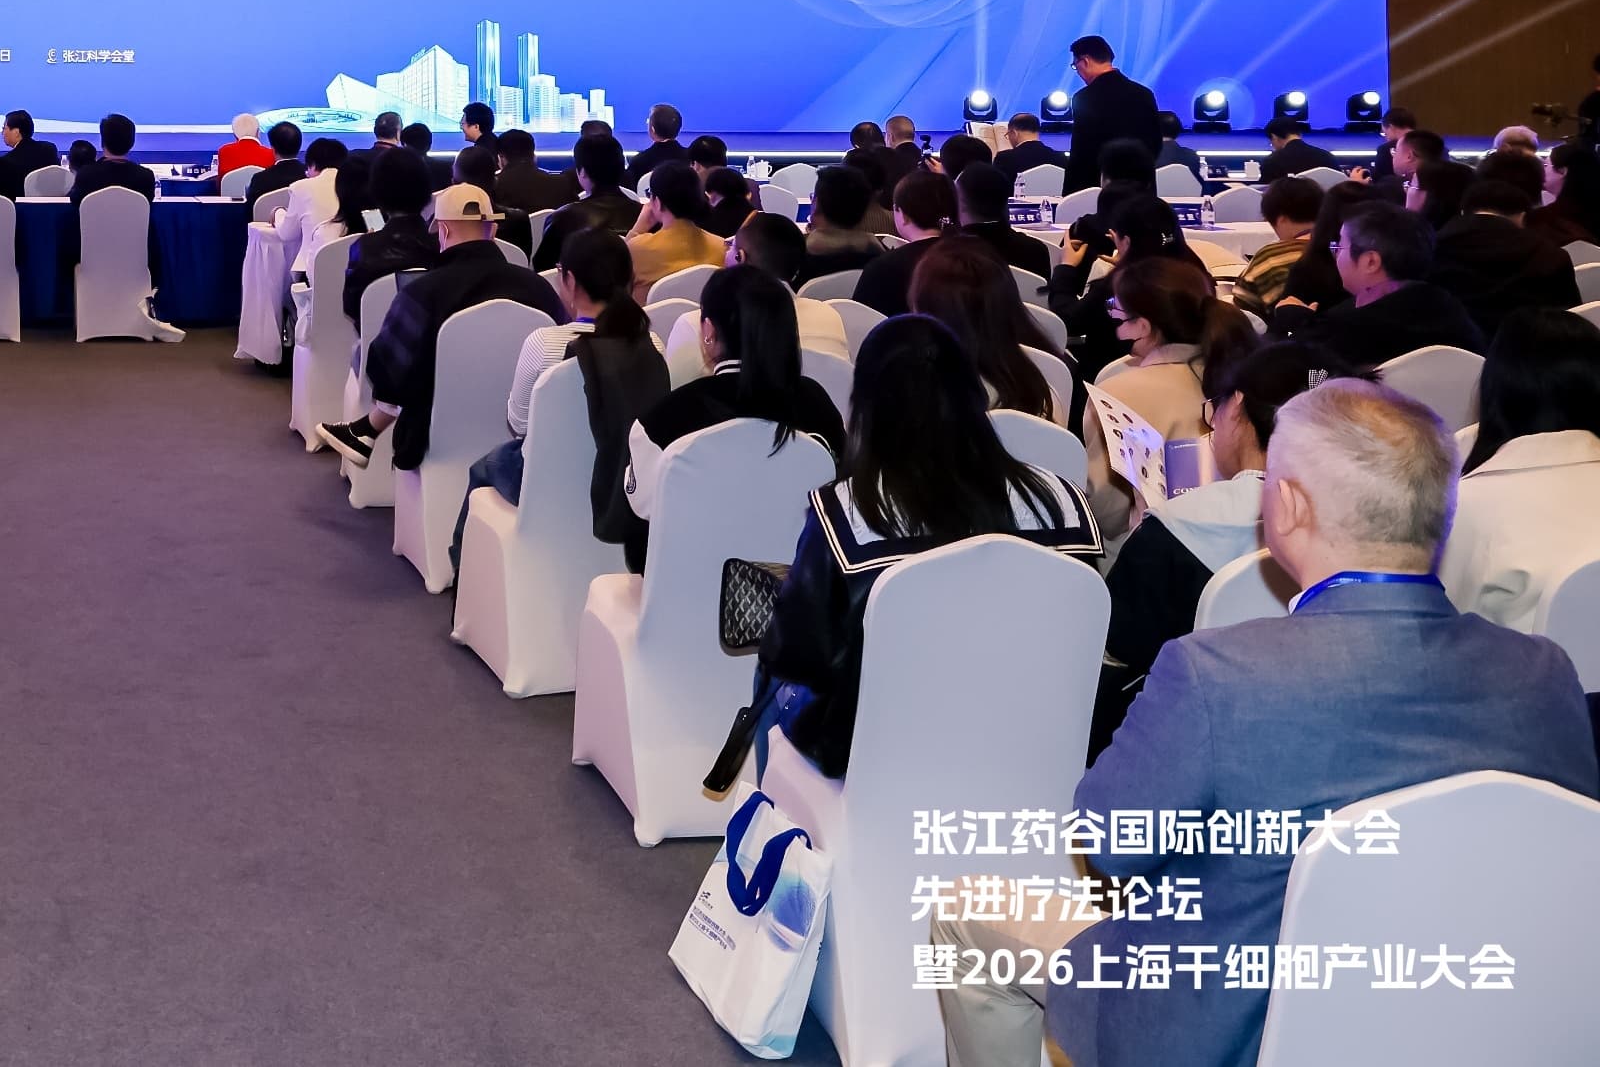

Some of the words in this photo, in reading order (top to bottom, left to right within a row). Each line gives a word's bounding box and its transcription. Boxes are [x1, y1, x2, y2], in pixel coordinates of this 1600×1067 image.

[62, 49, 135, 63] 张江科学会堂
